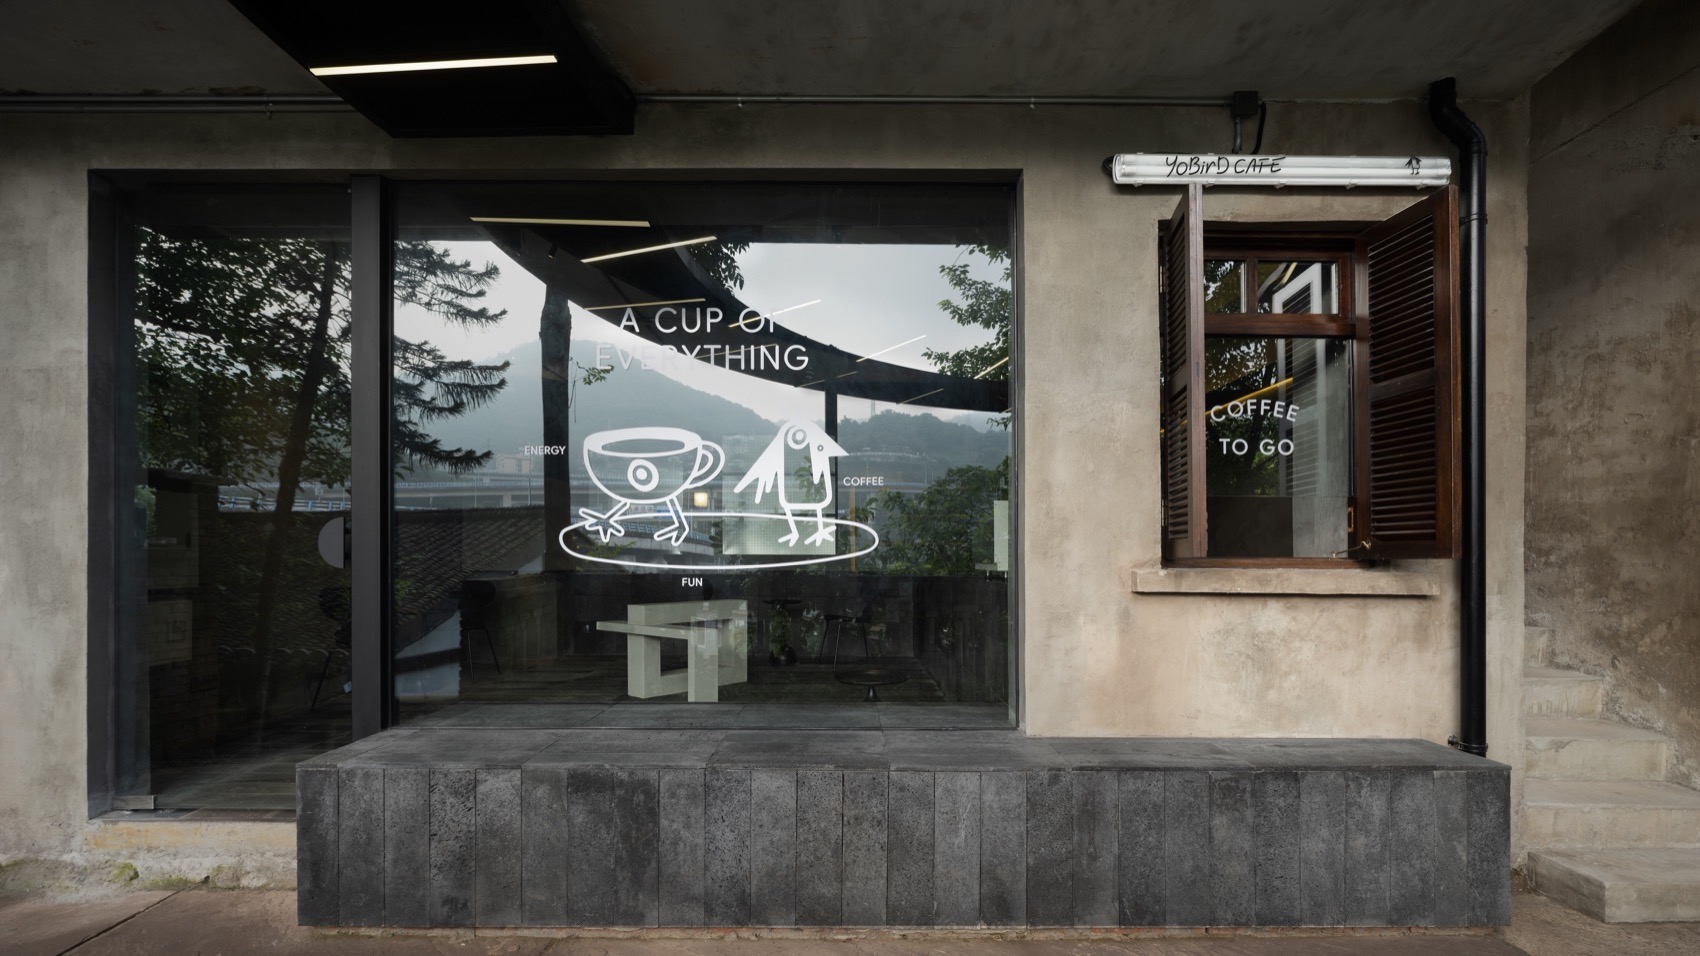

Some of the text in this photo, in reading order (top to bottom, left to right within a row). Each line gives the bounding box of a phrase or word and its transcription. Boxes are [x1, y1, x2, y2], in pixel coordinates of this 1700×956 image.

[619, 307, 640, 333] A
[654, 307, 723, 333] CUP
[596, 344, 809, 371] EVERYTHING
[1210, 399, 1300, 422] COFFEE
[524, 445, 566, 456] ENERGY
[1219, 438, 1294, 456] TO GO
[843, 476, 884, 486] COFFEE
[681, 577, 703, 587] FUN
